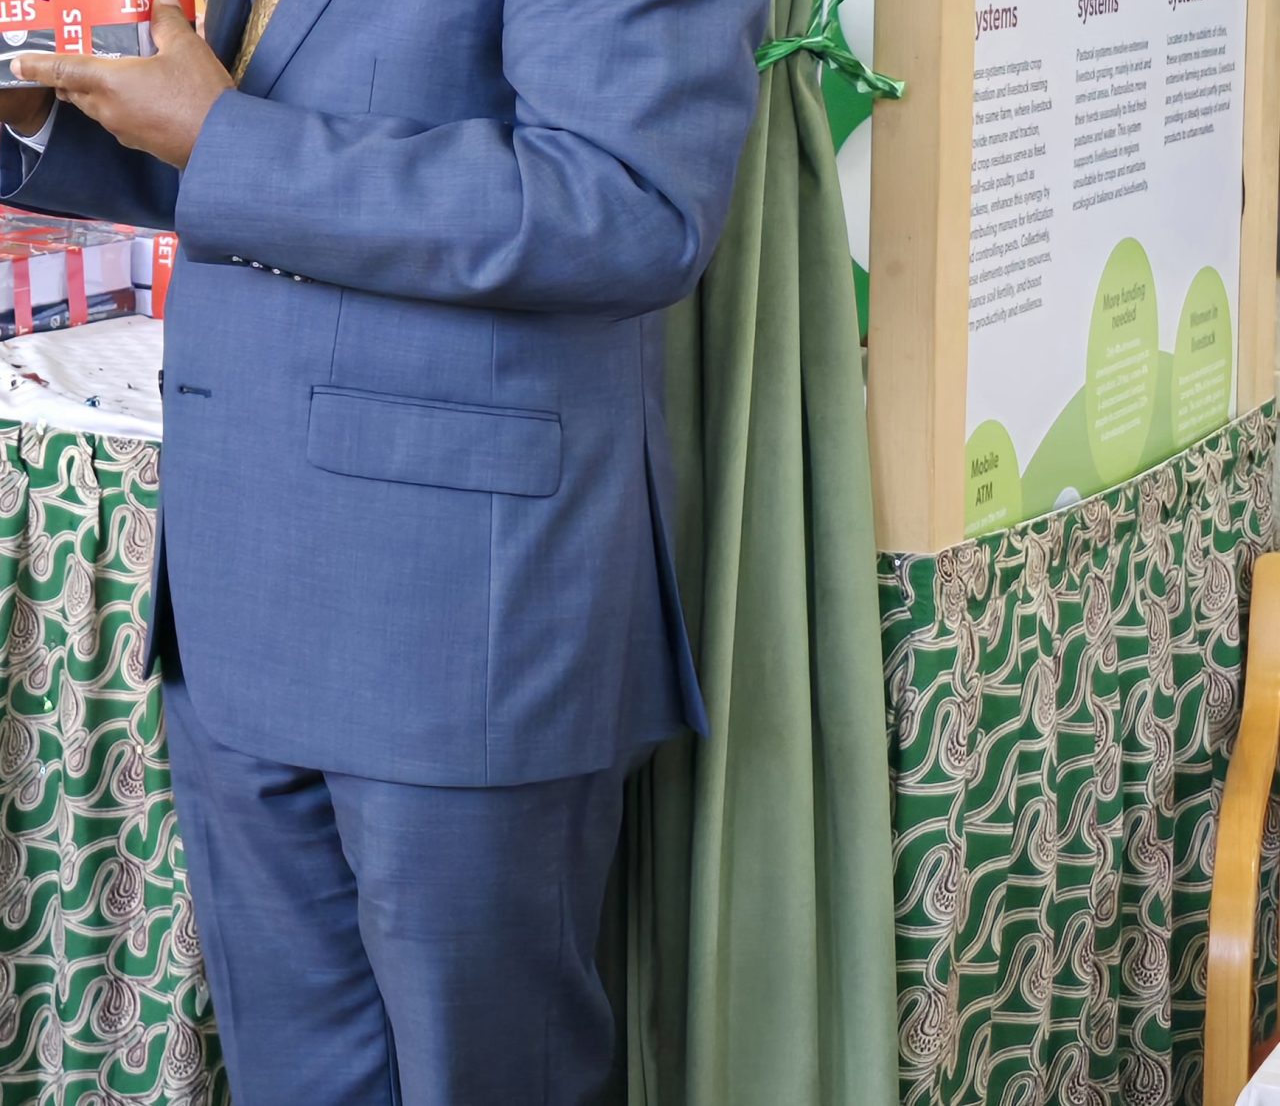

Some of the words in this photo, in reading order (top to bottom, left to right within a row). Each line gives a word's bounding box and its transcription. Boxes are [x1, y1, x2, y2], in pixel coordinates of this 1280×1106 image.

[63, 9, 83, 54] SET
[975, 4, 1018, 40] ystems
[158, 236, 173, 268] SET
[971, 451, 999, 479] Mobile
[975, 481, 993, 507] ATM
